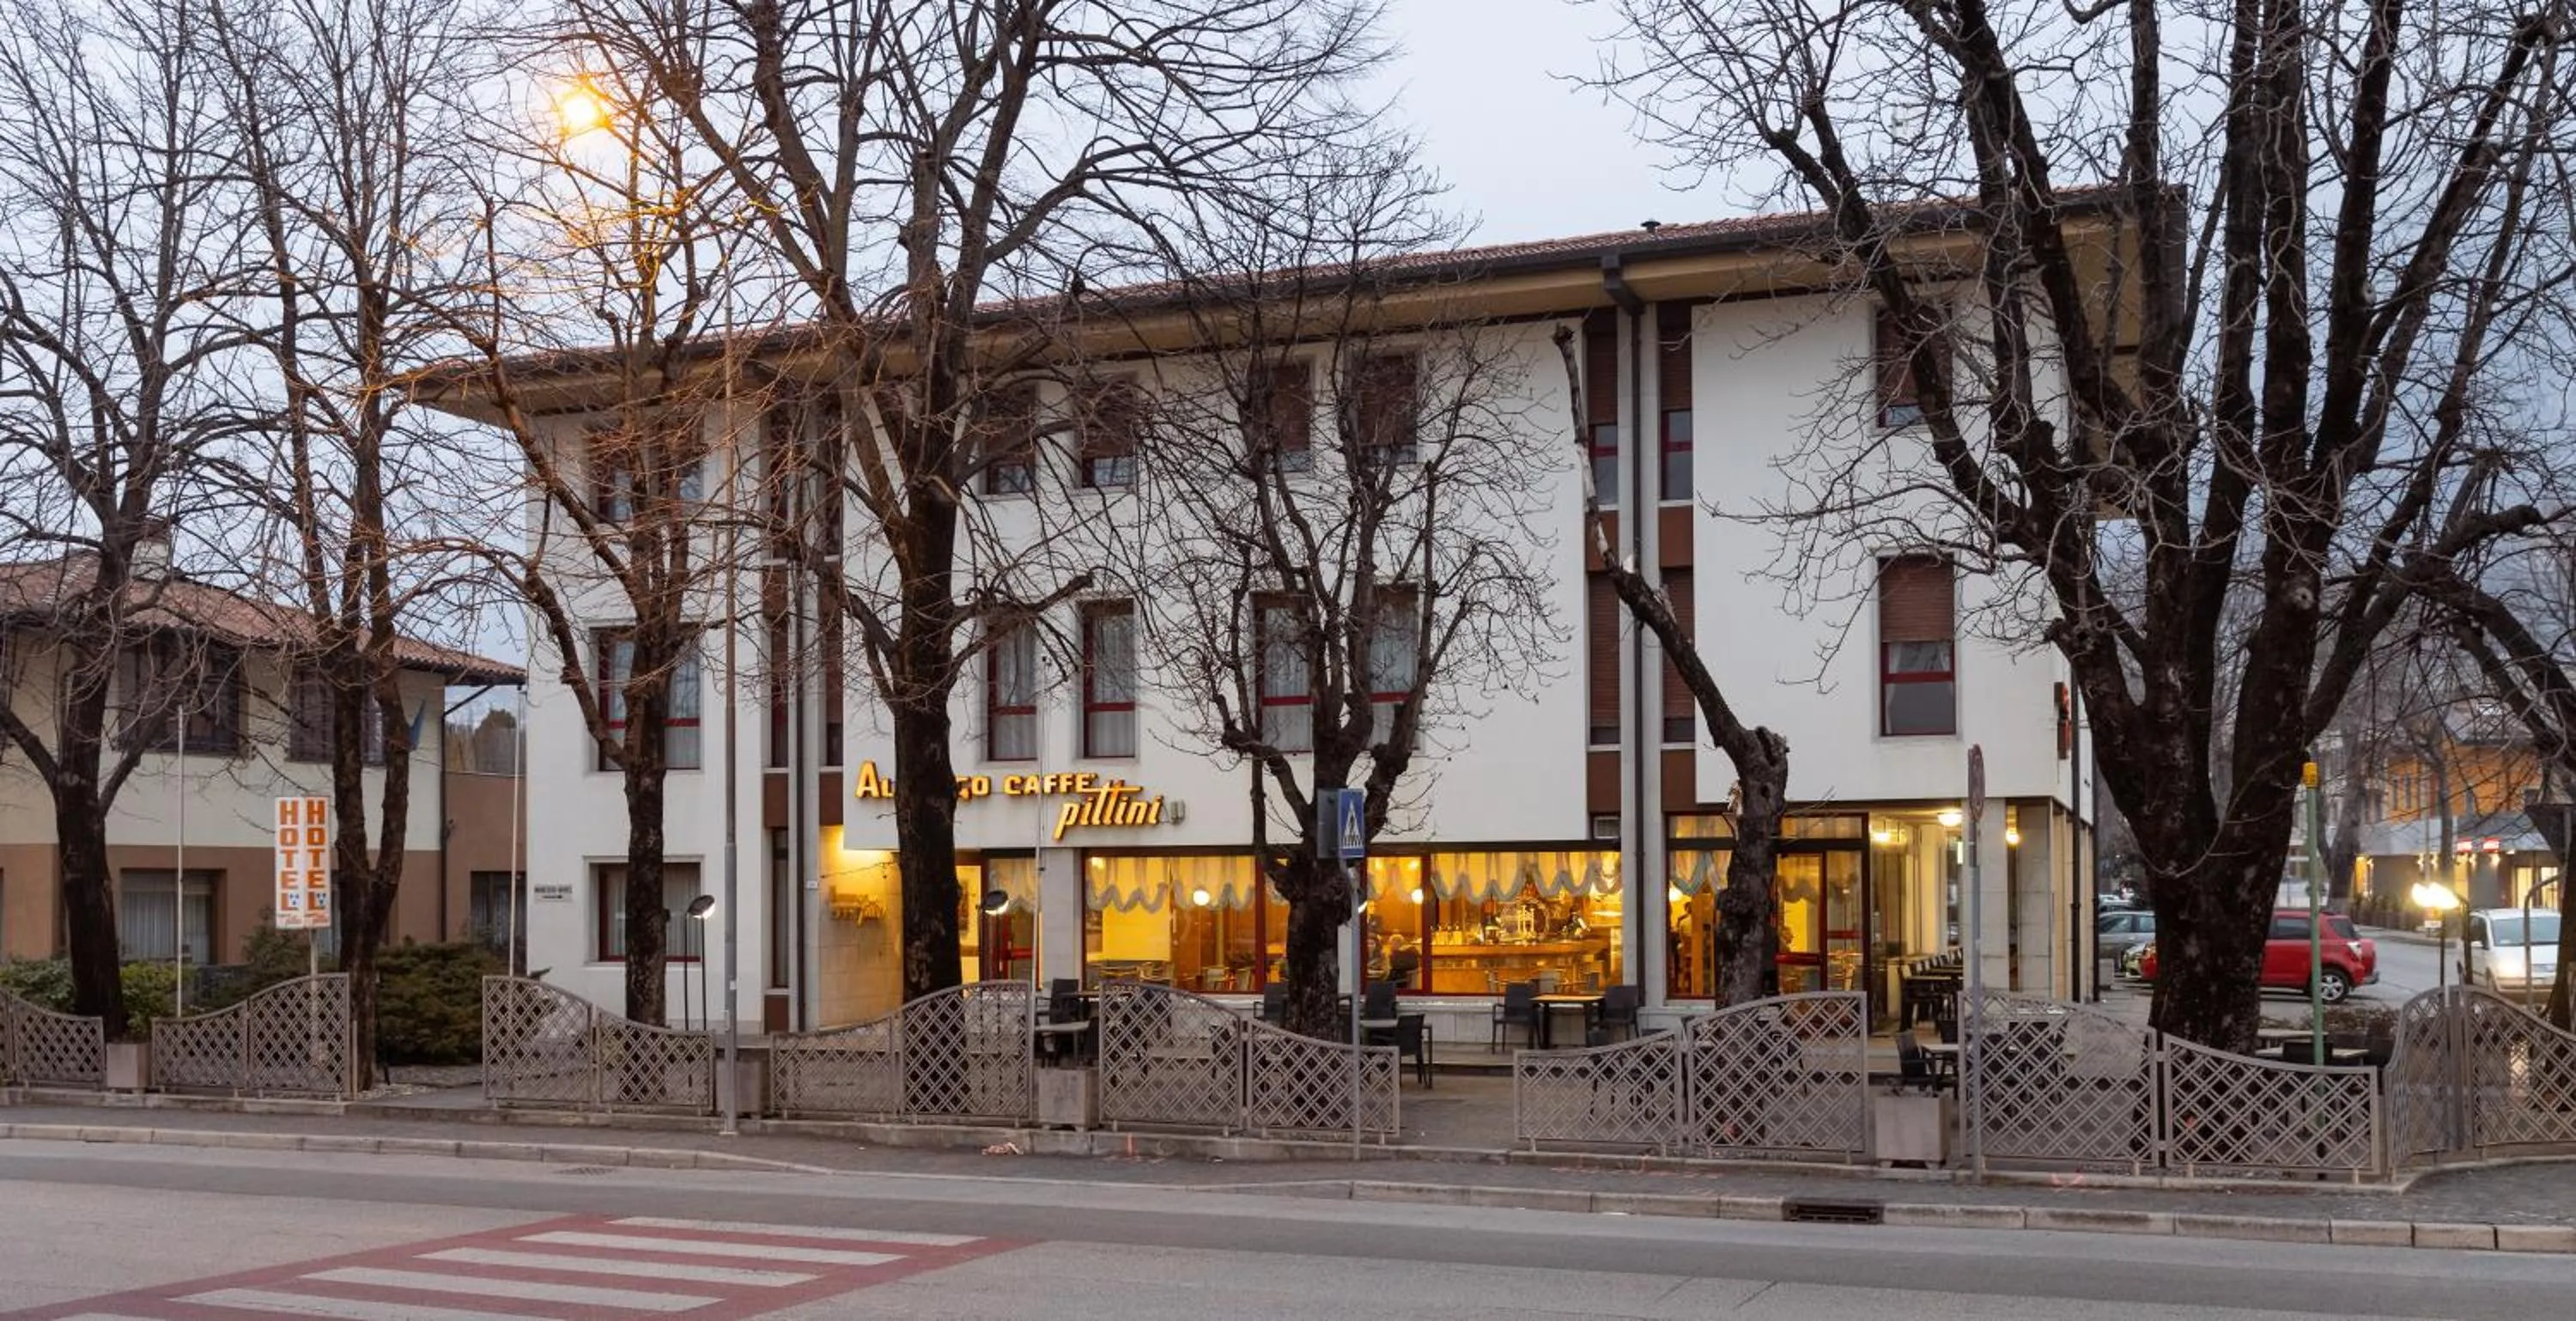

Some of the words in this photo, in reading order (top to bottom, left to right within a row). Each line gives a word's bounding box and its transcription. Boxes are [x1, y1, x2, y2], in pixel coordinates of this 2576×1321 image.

[855, 759, 991, 799] ALGO
[1053, 779, 1164, 842] pittini
[279, 800, 299, 911] HOTEL
[307, 800, 325, 910] HOTEL
